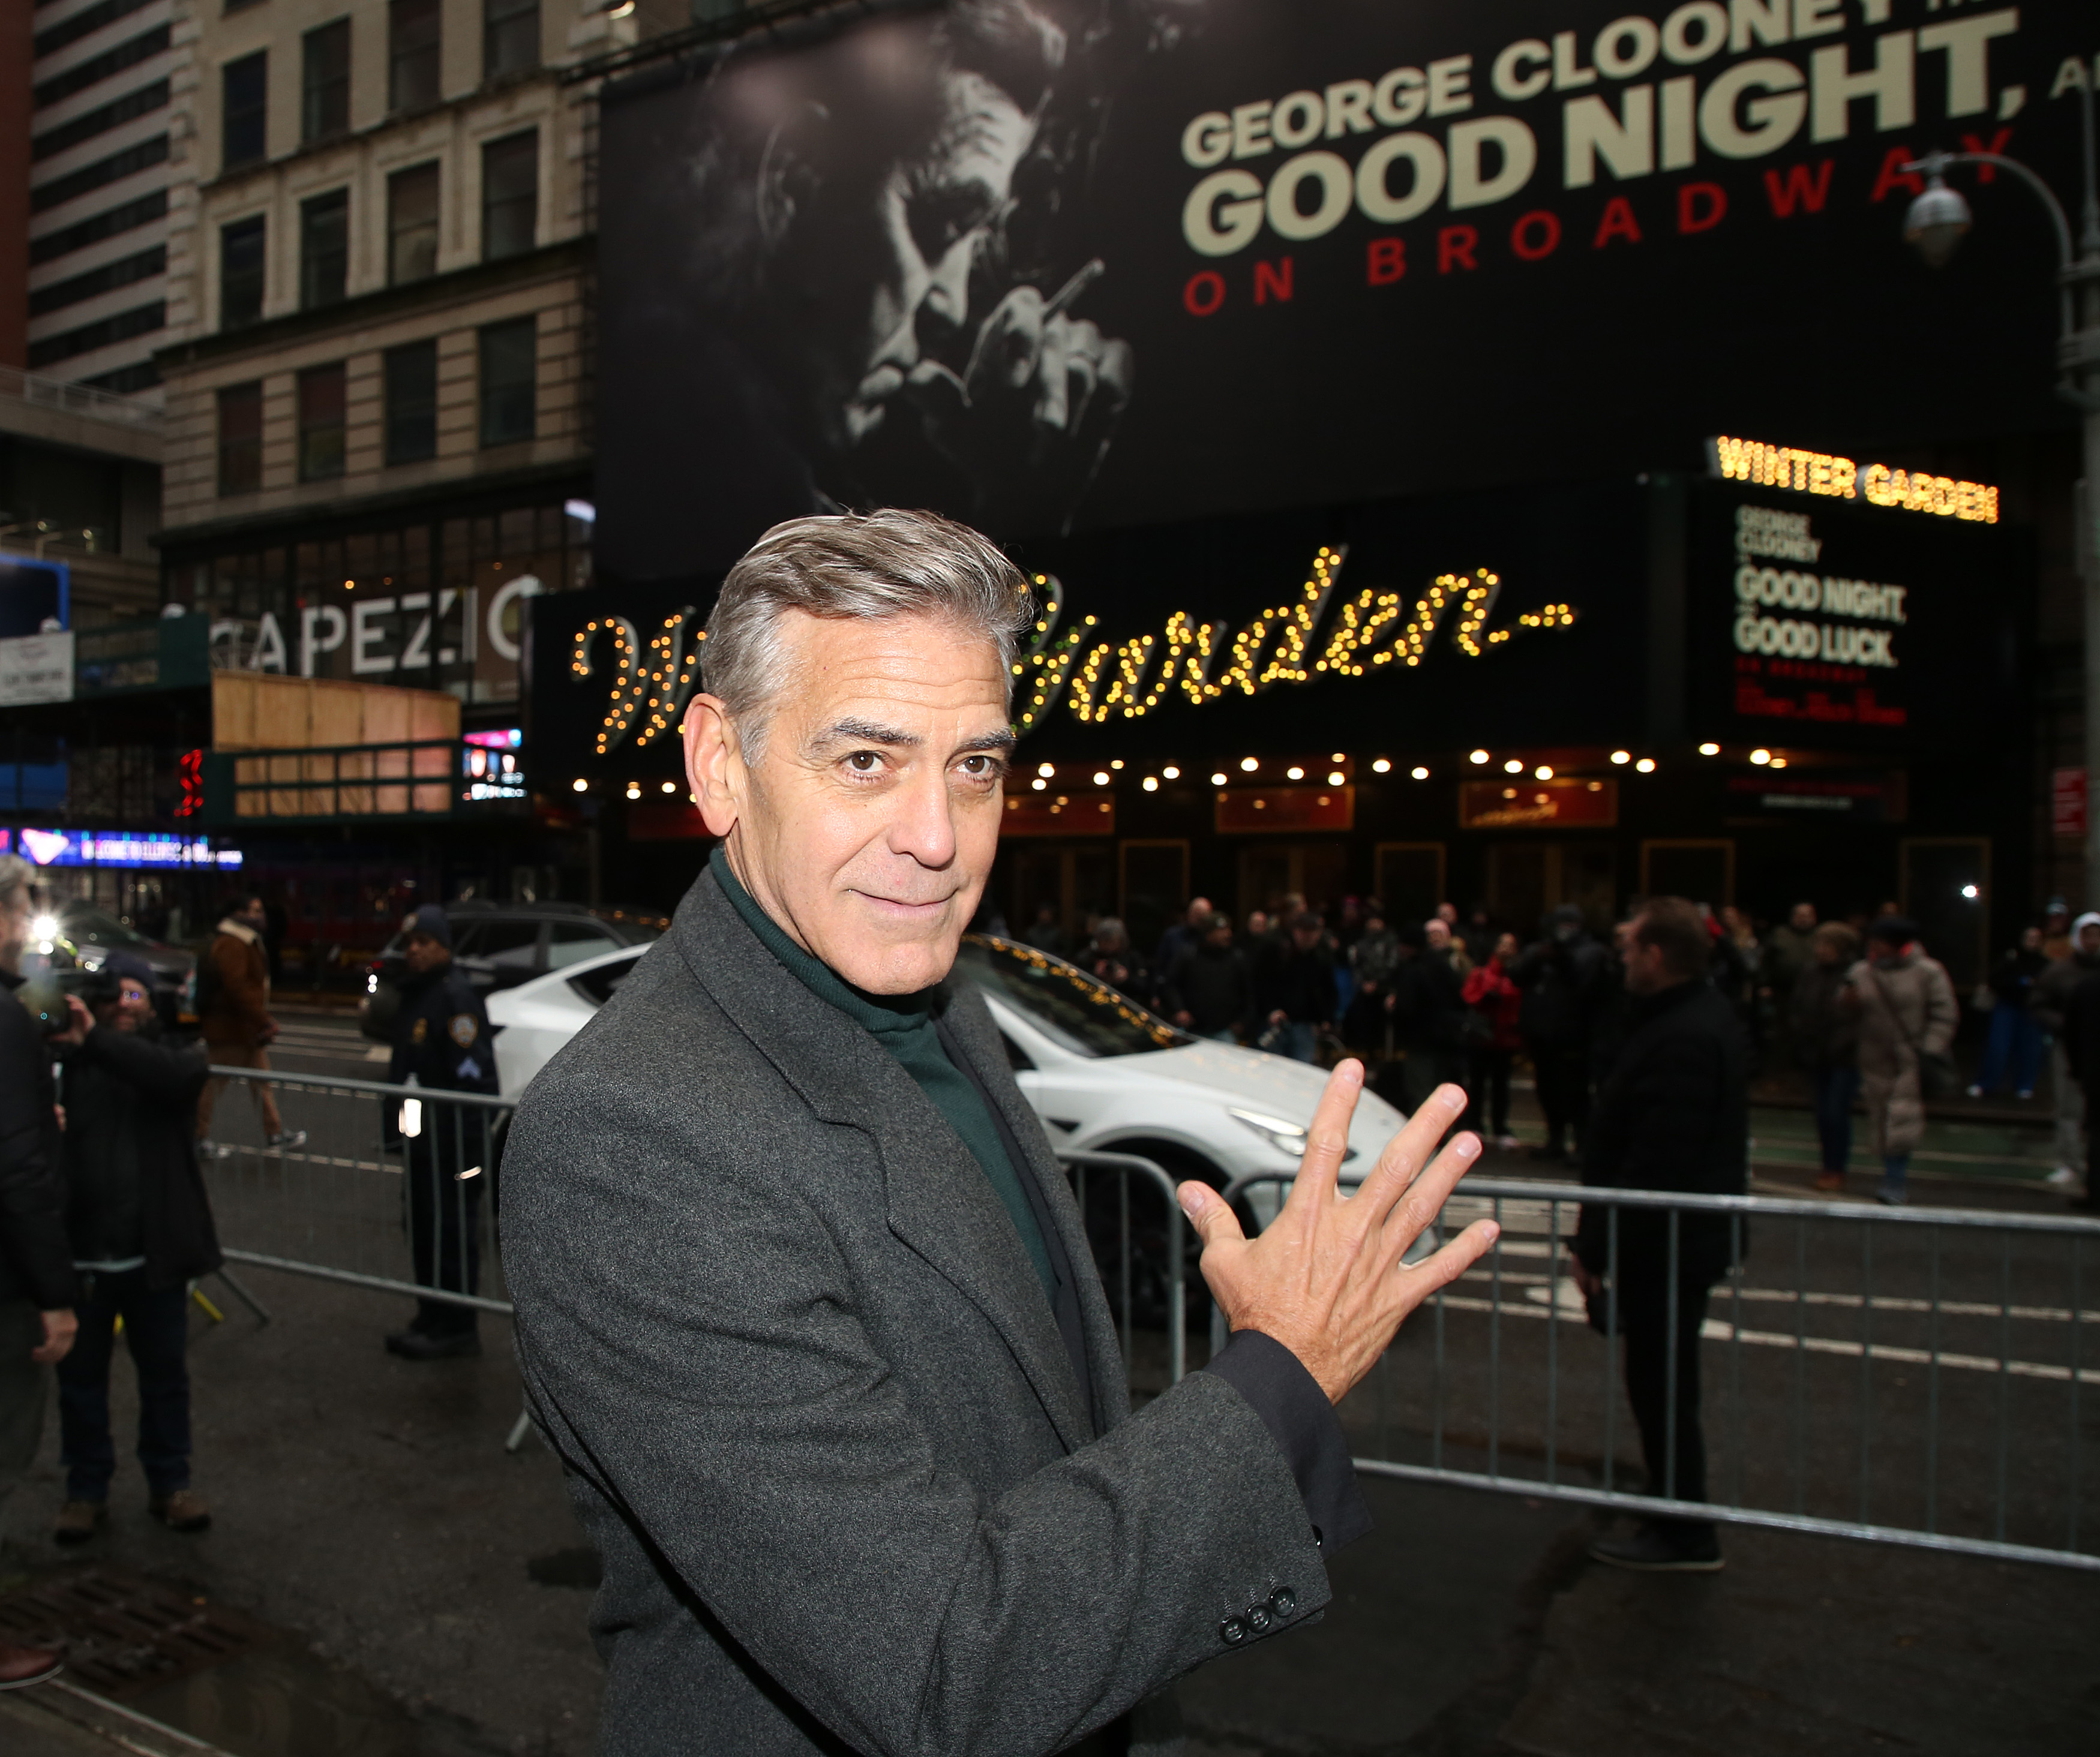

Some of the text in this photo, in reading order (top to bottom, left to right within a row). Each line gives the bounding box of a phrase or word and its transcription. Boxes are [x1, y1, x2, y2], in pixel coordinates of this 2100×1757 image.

[1181, 54, 1473, 168] GEORGE
[1182, 116, 1537, 257] GOOD
[1563, 8, 2026, 190] NIGHT,
[1183, 128, 2013, 317] ON BROADWAY
[1717, 436, 1998, 524] WINTER GARDEN
[1733, 615, 1821, 659] GOOD
[1734, 563, 1822, 611] GOOD
